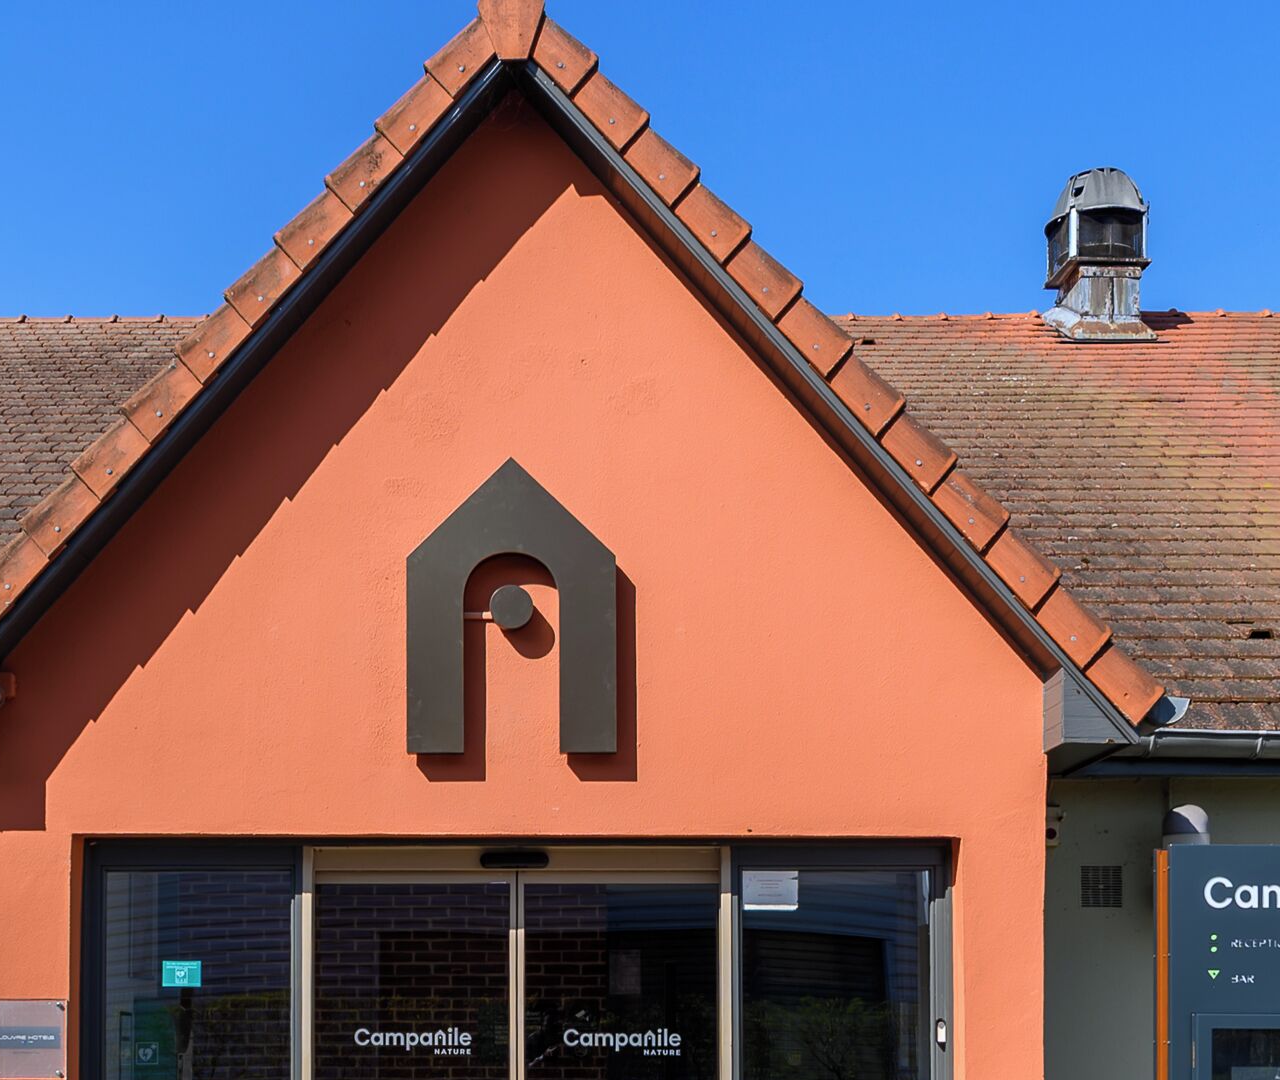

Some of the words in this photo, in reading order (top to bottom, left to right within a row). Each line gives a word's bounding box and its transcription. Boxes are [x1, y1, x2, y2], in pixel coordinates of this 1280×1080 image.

[1231, 974, 1255, 984] BAR
[354, 1027, 472, 1051] Campanile
[563, 1028, 682, 1052] Campanile
